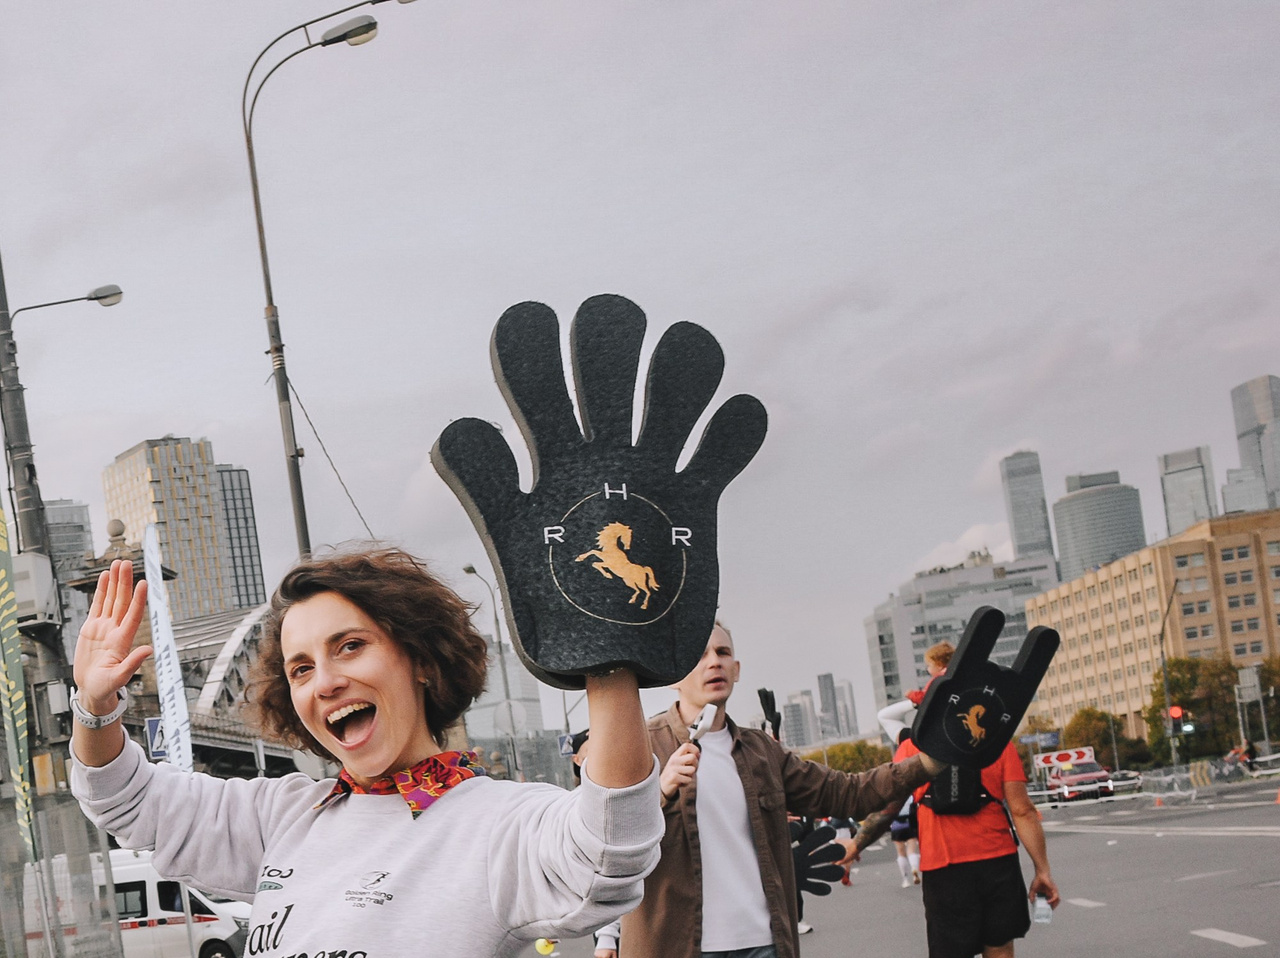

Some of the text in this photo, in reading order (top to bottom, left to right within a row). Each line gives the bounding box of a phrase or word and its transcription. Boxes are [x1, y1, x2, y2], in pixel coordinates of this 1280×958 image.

[543, 482, 693, 547] R H R
[372, 890, 394, 902] Ring
[248, 903, 295, 956] ail
